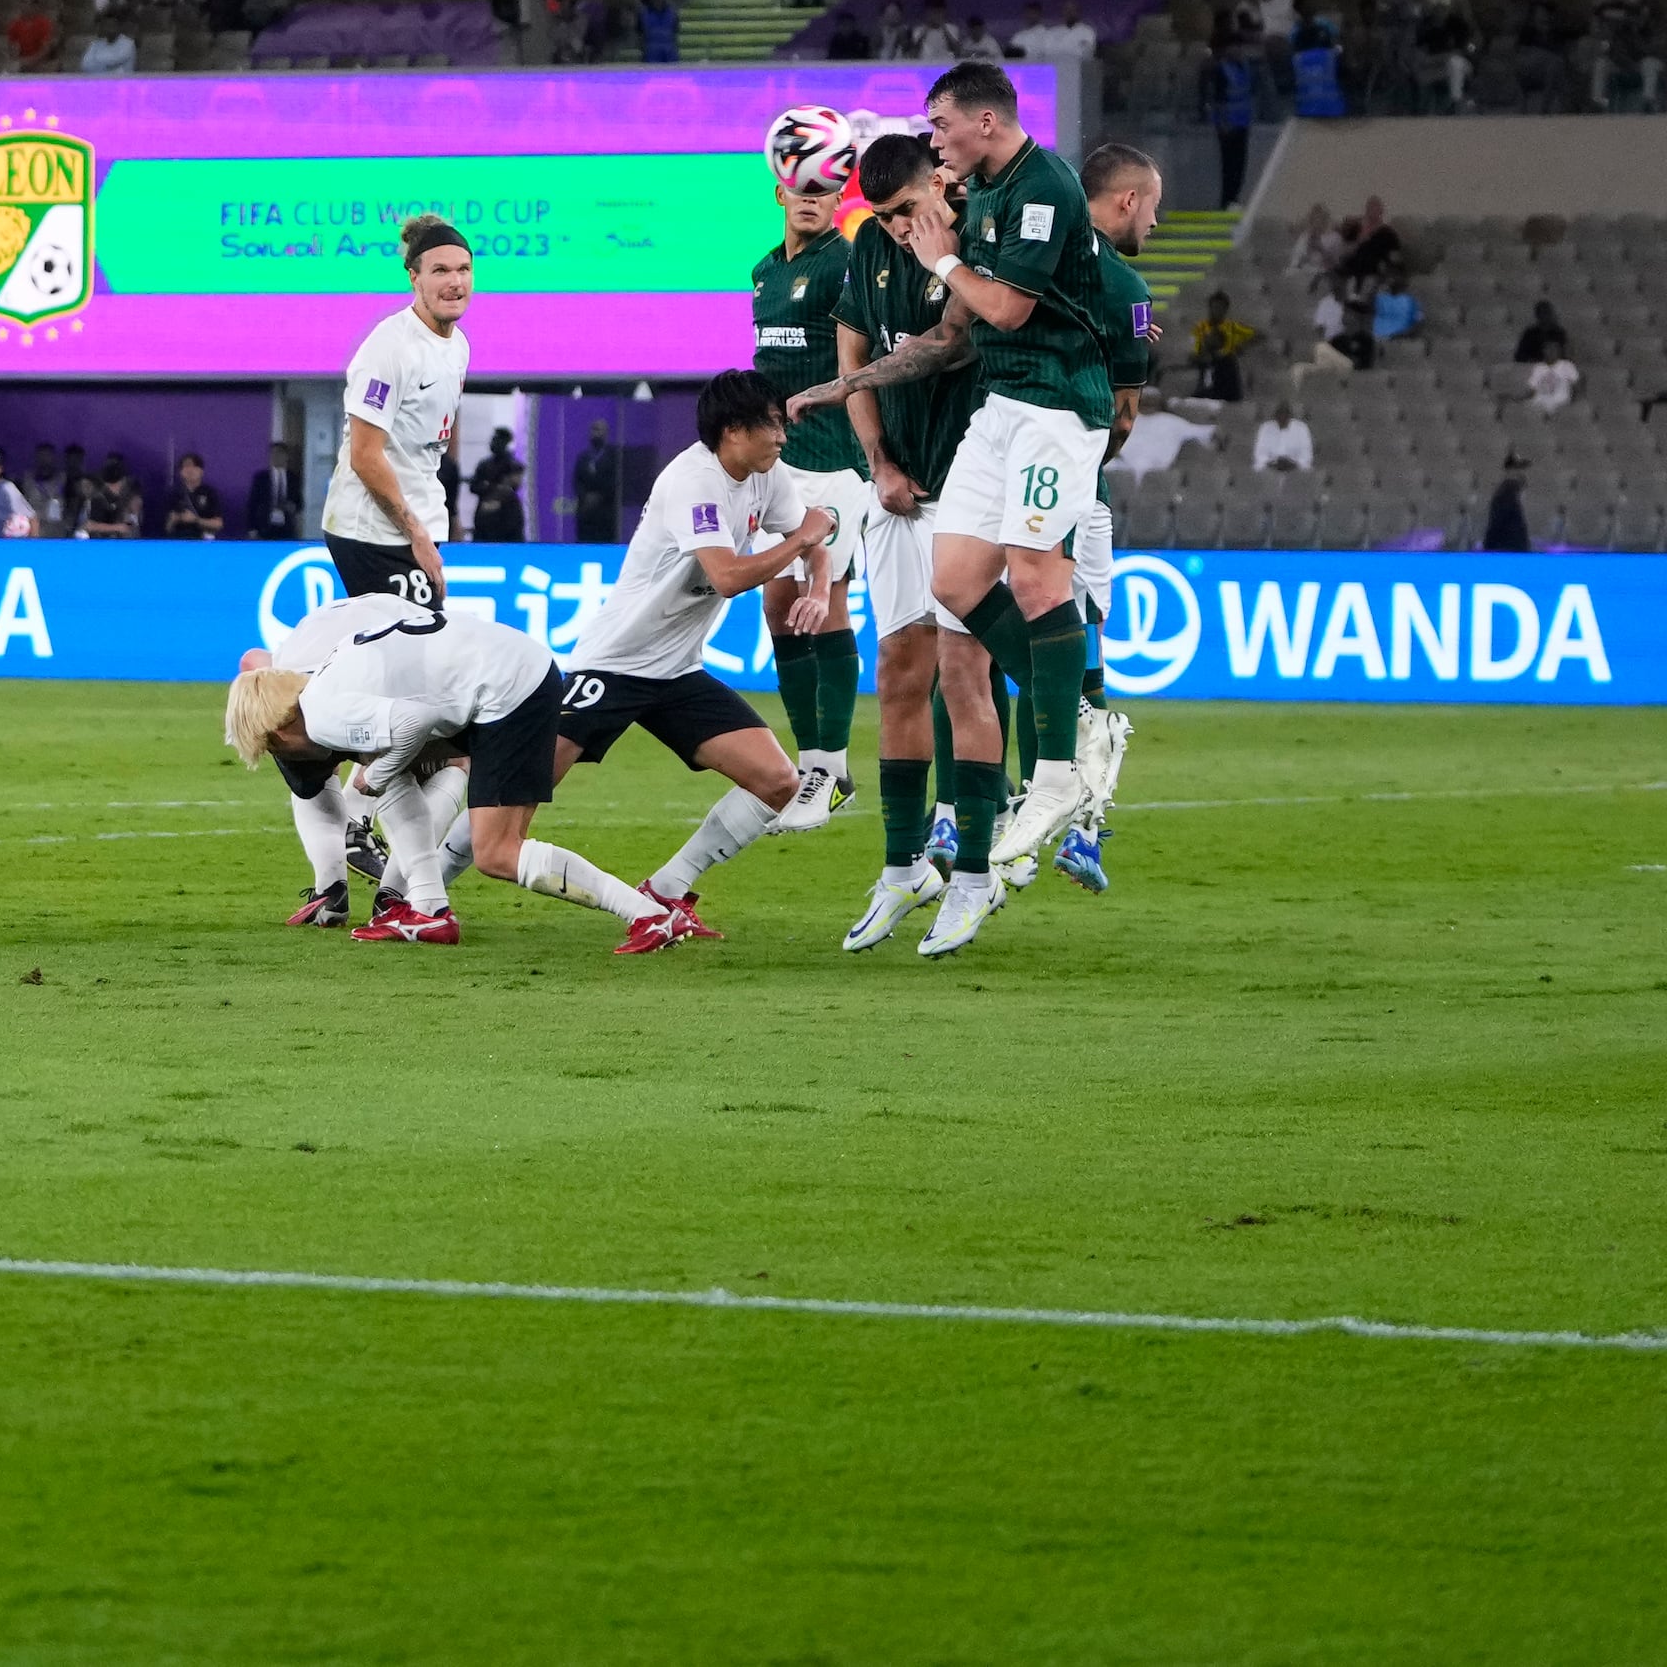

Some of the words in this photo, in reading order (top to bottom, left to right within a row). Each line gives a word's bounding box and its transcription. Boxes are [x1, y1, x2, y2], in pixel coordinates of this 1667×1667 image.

[221, 201, 283, 226] FIFA
[294, 201, 366, 225] CLUB
[494, 199, 550, 224] CUP
[1019, 464, 1059, 511] 18
[1218, 581, 1612, 682] WANDA
[562, 675, 605, 708] 19
